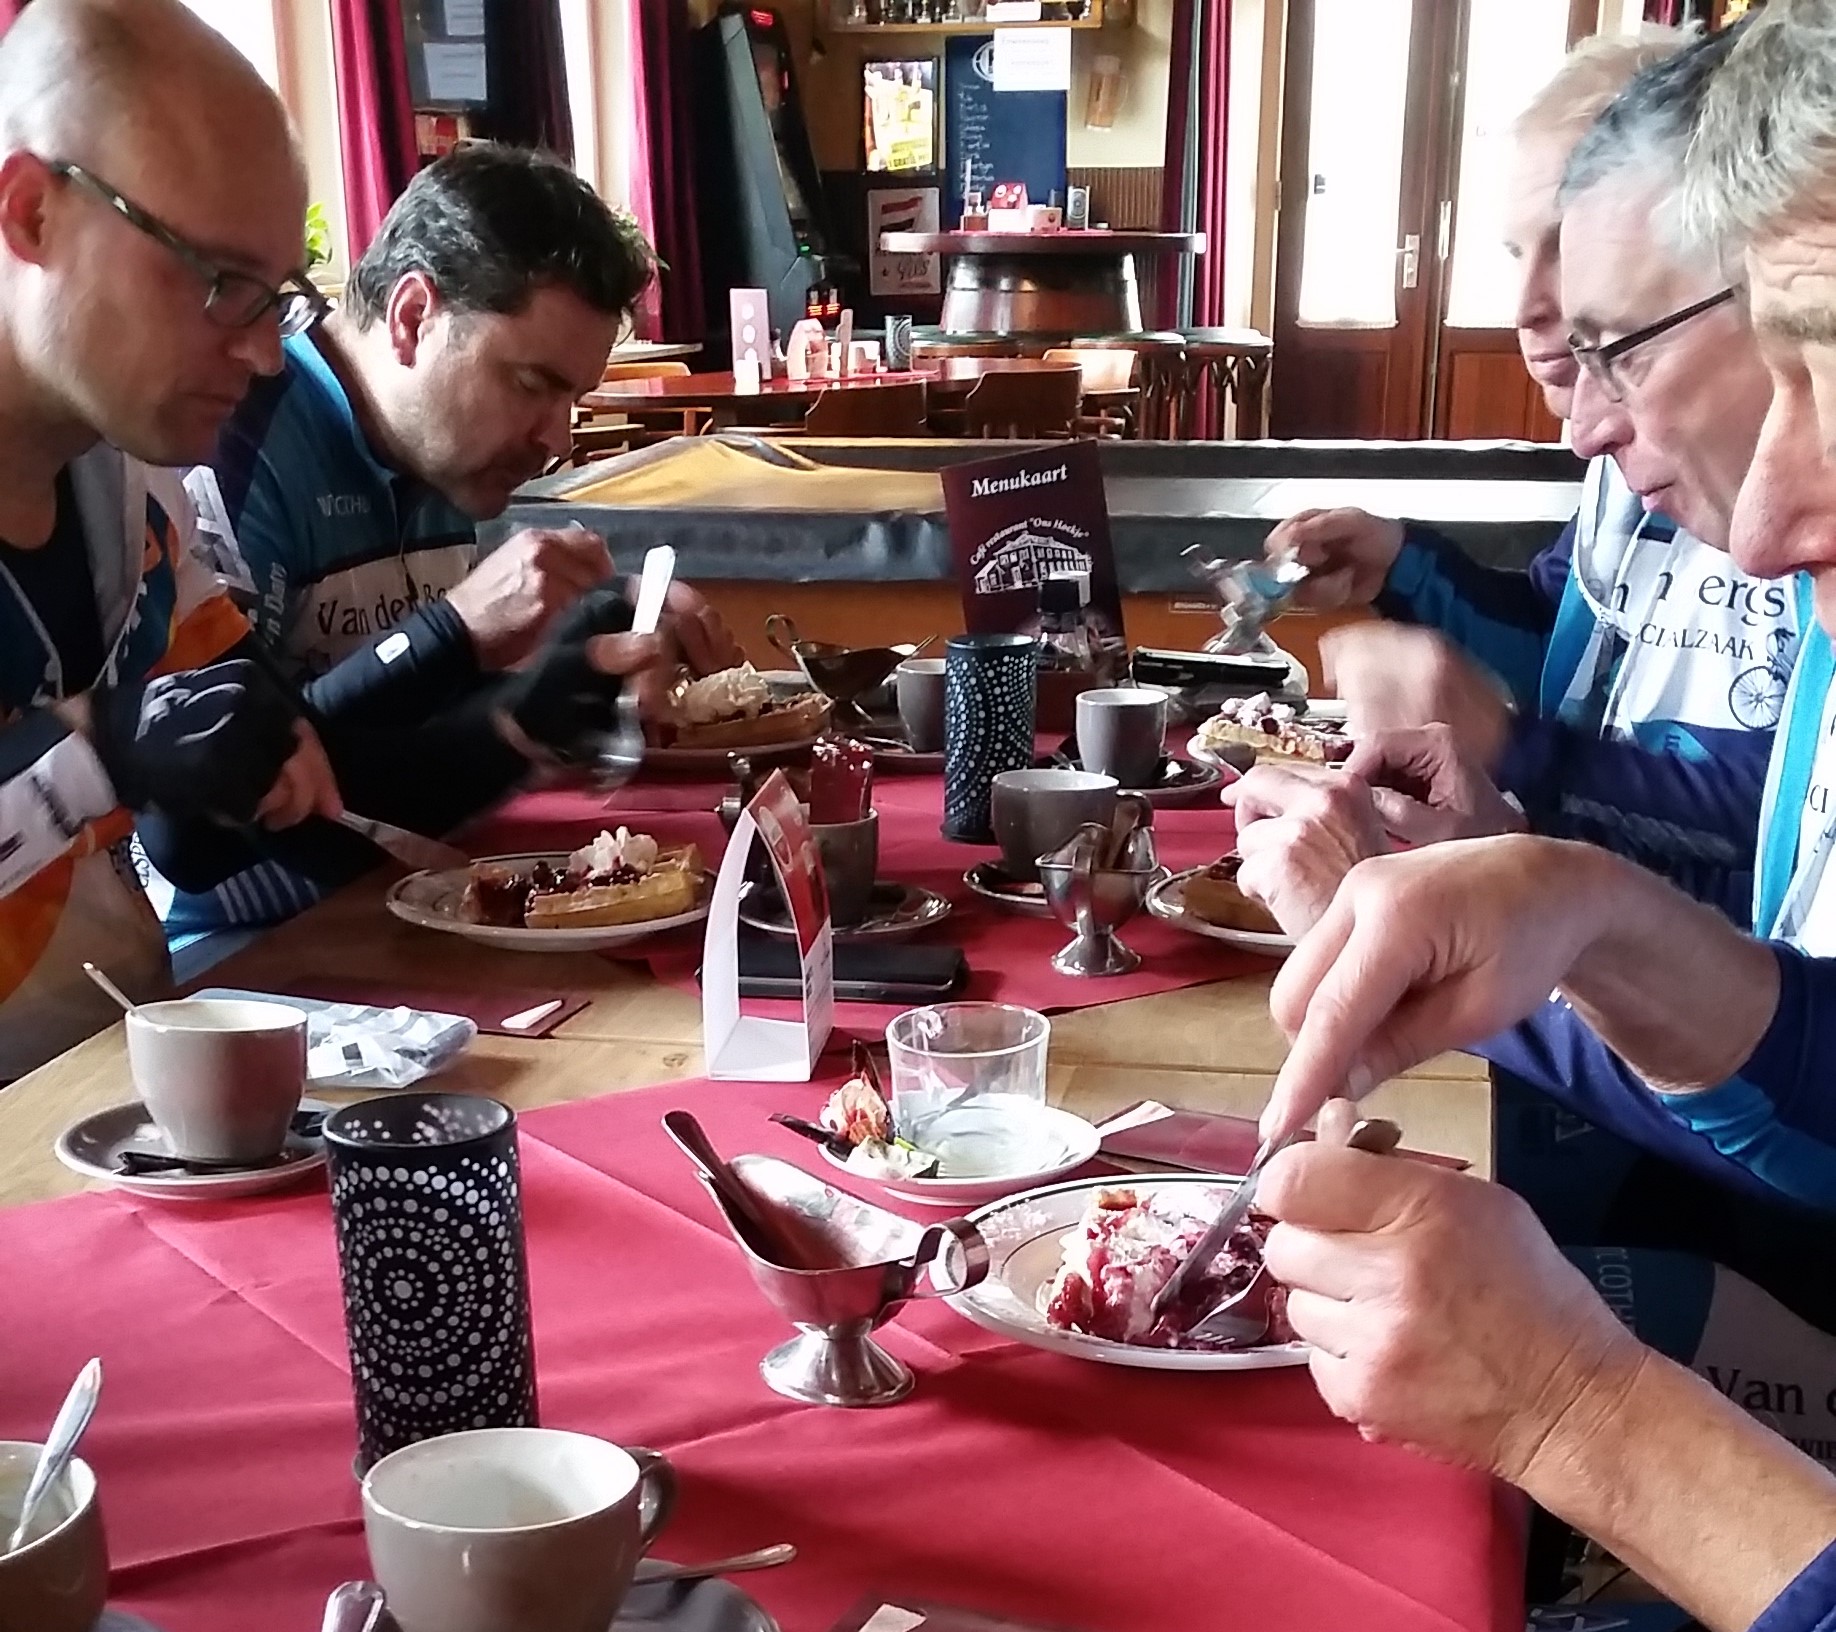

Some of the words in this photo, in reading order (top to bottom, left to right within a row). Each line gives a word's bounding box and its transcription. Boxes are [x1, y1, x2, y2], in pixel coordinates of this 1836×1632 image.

[970, 463, 1069, 498] Menukaart
[985, 520, 1028, 548] restaurant
[317, 600, 371, 636] Van
[1640, 622, 1754, 661] CIALZAAK
[1706, 1366, 1803, 1415] Van
